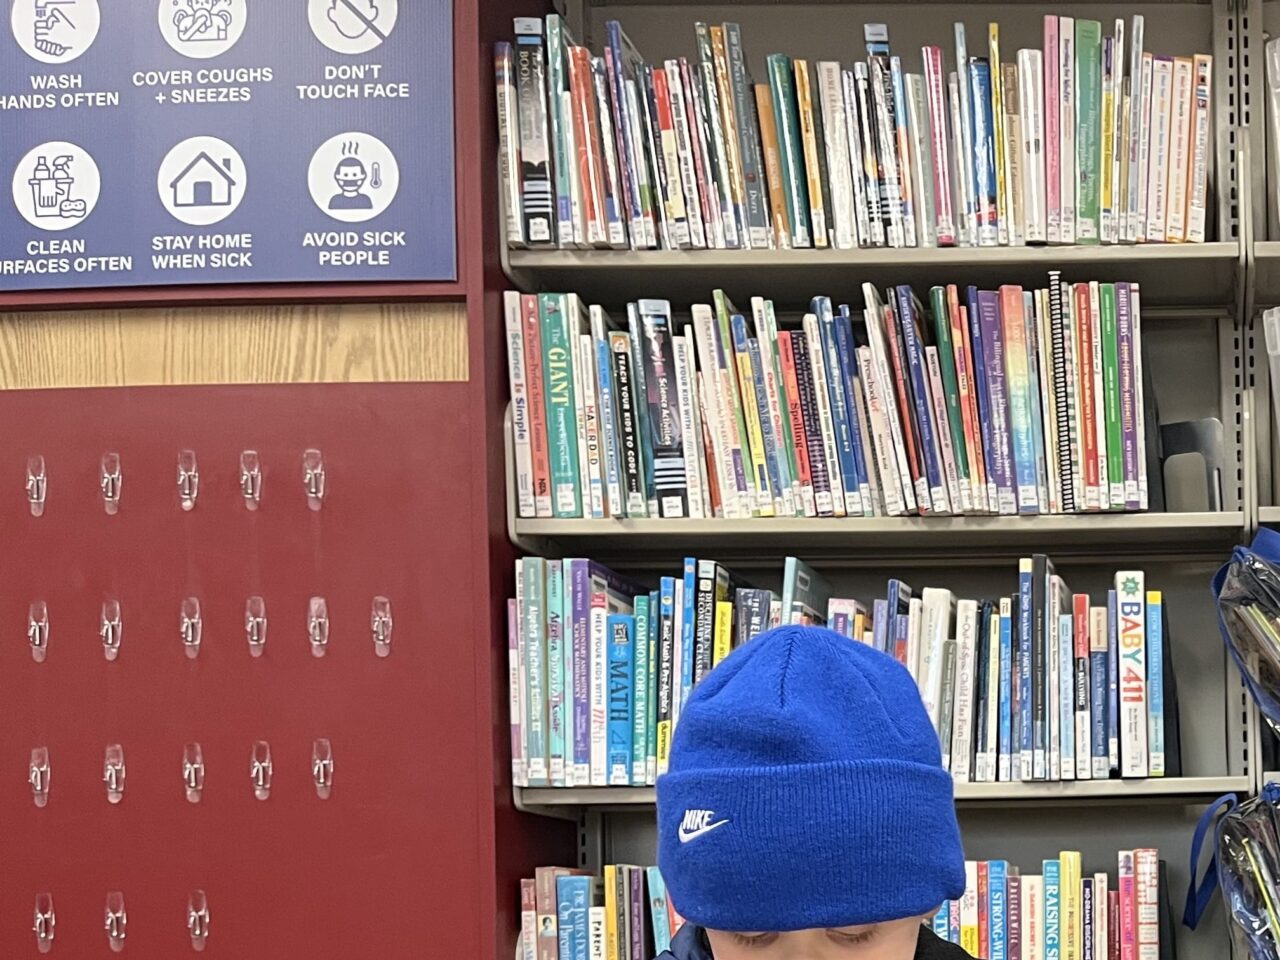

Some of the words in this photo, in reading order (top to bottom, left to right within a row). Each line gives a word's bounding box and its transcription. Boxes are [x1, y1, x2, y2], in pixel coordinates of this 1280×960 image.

[132, 71, 193, 86] COVER
[196, 67, 273, 84] COUGHS
[325, 64, 382, 80] DON'T
[519, 51, 530, 86] BOOK
[31, 74, 82, 90] WASH
[296, 85, 359, 100] TOUCH
[363, 83, 409, 98] FACE
[0, 94, 56, 110] HANDS
[60, 92, 119, 108] OFTEN
[171, 87, 251, 103] SNEEZES
[26, 240, 85, 255] CLEAN
[152, 236, 194, 250] STAY
[199, 234, 252, 249] HOME
[303, 232, 359, 247] AVOID
[363, 231, 406, 246] SICK
[73, 256, 132, 272] OFTEN
[152, 254, 206, 269] WHEN
[209, 252, 252, 267] SICK
[319, 250, 390, 266] PEOPLE
[551, 327, 561, 344] The
[511, 333, 521, 379] Science
[991, 341, 1004, 377] Bilingual
[548, 347, 569, 406] GIANT
[618, 355, 627, 383] TEACH
[678, 362, 687, 387] YOUR
[863, 359, 875, 400] Preschool
[514, 383, 522, 394] Is
[620, 386, 629, 410] YOUR
[658, 378, 668, 408] Science
[681, 389, 689, 407] KIDS
[767, 372, 777, 399] Charts
[515, 397, 525, 440] Simple
[771, 400, 779, 412] for
[586, 406, 595, 442] MAKER
[623, 413, 631, 432] KIDS
[661, 409, 672, 446] Activities
[683, 409, 692, 430] WITH
[773, 414, 783, 448] Children
[790, 402, 805, 448] Spelling
[626, 436, 633, 447] TO
[588, 444, 598, 465] DAD
[627, 451, 636, 474] CODE
[1022, 582, 1030, 592] The
[1022, 595, 1030, 611] ADHD
[528, 606, 538, 638] Algebra
[594, 614, 603, 634] HELP
[697, 592, 705, 642] SECONDARY
[704, 593, 712, 639] DISCIPLINE
[1022, 612, 1030, 640] Workbook
[549, 611, 561, 651] Algebra
[579, 618, 587, 655] ELEMENTARY
[636, 615, 647, 665] COMMON
[662, 620, 671, 641] Basic
[1121, 602, 1142, 665] BABY
[595, 637, 603, 659] YOUR
[662, 643, 671, 662] Math
[959, 623, 971, 671] Out-of-Sync
[1022, 642, 1030, 650] for
[1151, 632, 1160, 672] CHILDREN
[529, 640, 541, 686] Teacher's
[595, 662, 603, 681] KIDS
[1022, 652, 1030, 679] PARENTS
[550, 654, 561, 701] Survival
[635, 668, 647, 698] CORE
[958, 672, 969, 697] Child
[1123, 667, 1143, 703] 411
[1152, 675, 1161, 704] THRIVE
[595, 683, 603, 705] WITH
[610, 660, 629, 722] MATH
[660, 669, 671, 713] Pre-Algebra
[551, 704, 561, 733] Guide
[635, 701, 646, 733] MATH
[958, 699, 968, 716] Has
[957, 718, 967, 737] Fun
[683, 809, 715, 829] NIKE
[1124, 880, 1134, 895] the
[560, 902, 571, 920] On
[574, 908, 586, 938] JAMES
[1046, 885, 1059, 945] RAISING
[1124, 896, 1133, 931] science
[592, 920, 602, 957] PARENT
[1125, 932, 1134, 942] of
